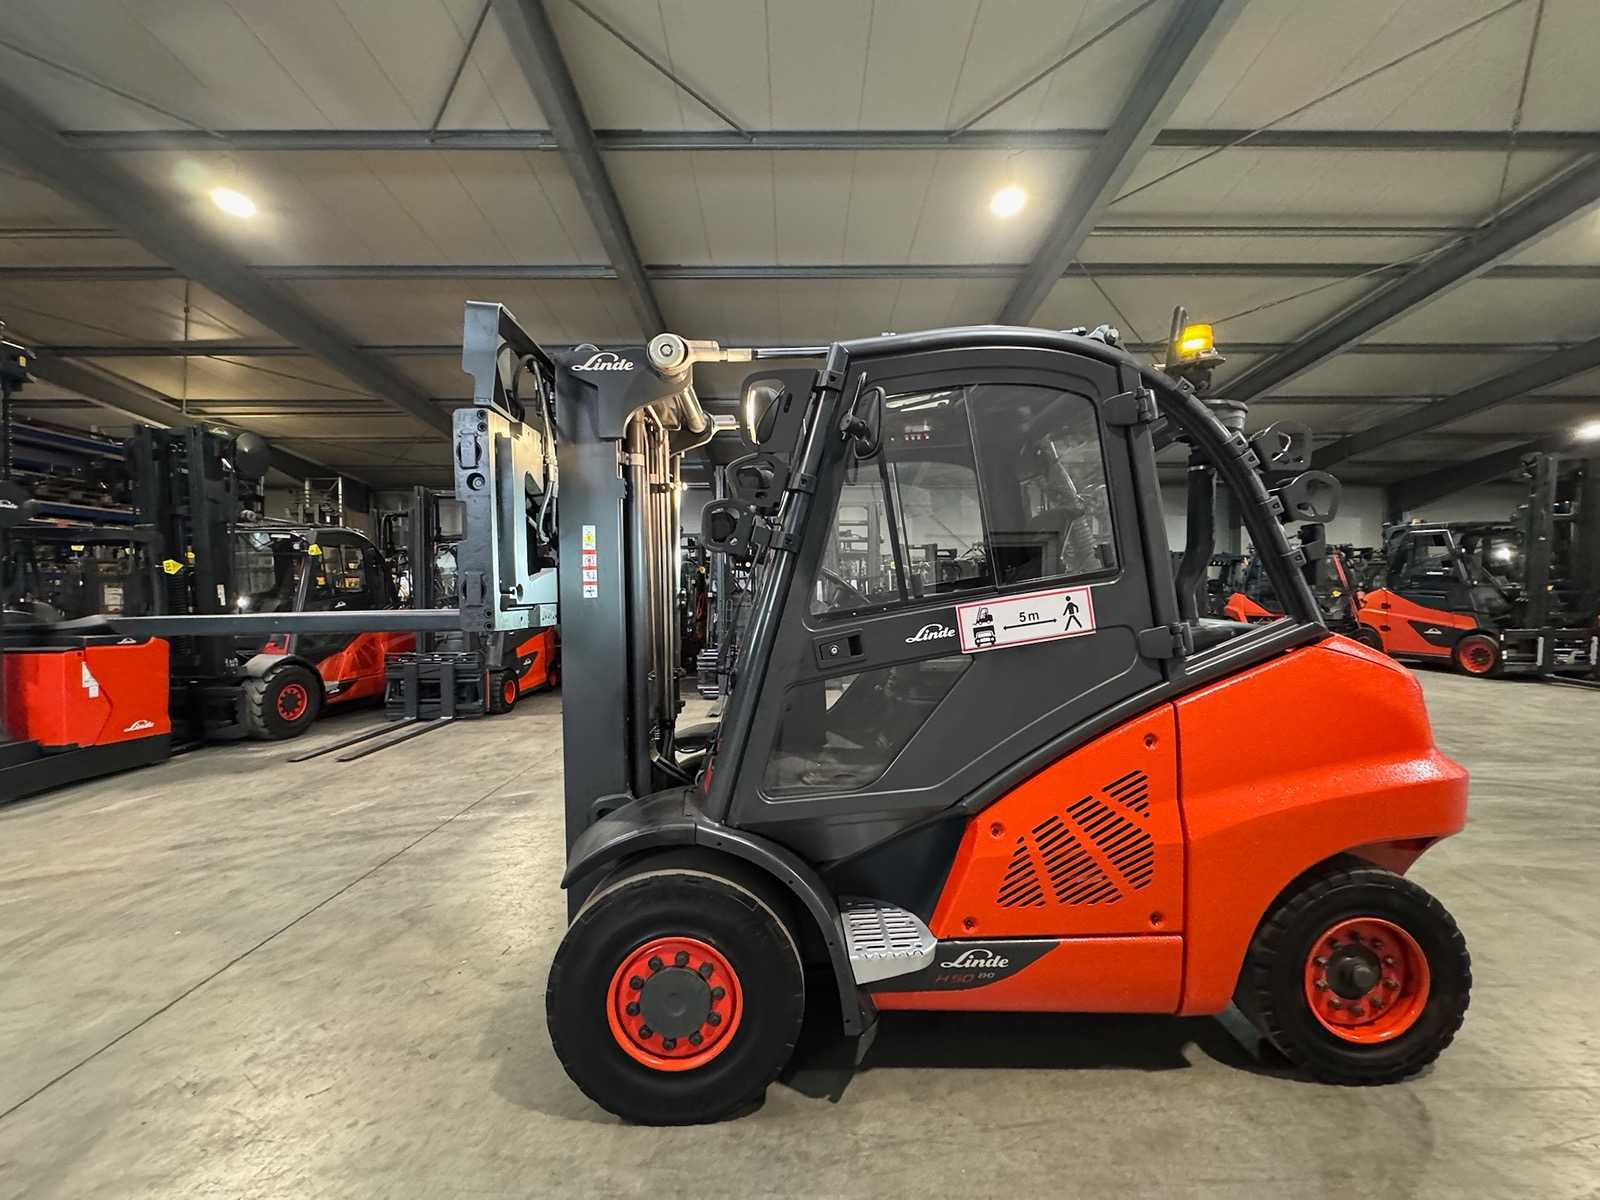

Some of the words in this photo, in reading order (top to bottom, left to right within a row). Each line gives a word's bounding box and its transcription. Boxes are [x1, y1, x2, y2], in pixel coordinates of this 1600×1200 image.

[572, 353, 634, 371] Linde
[905, 623, 956, 643] Linde
[941, 949, 1008, 968] Linde
